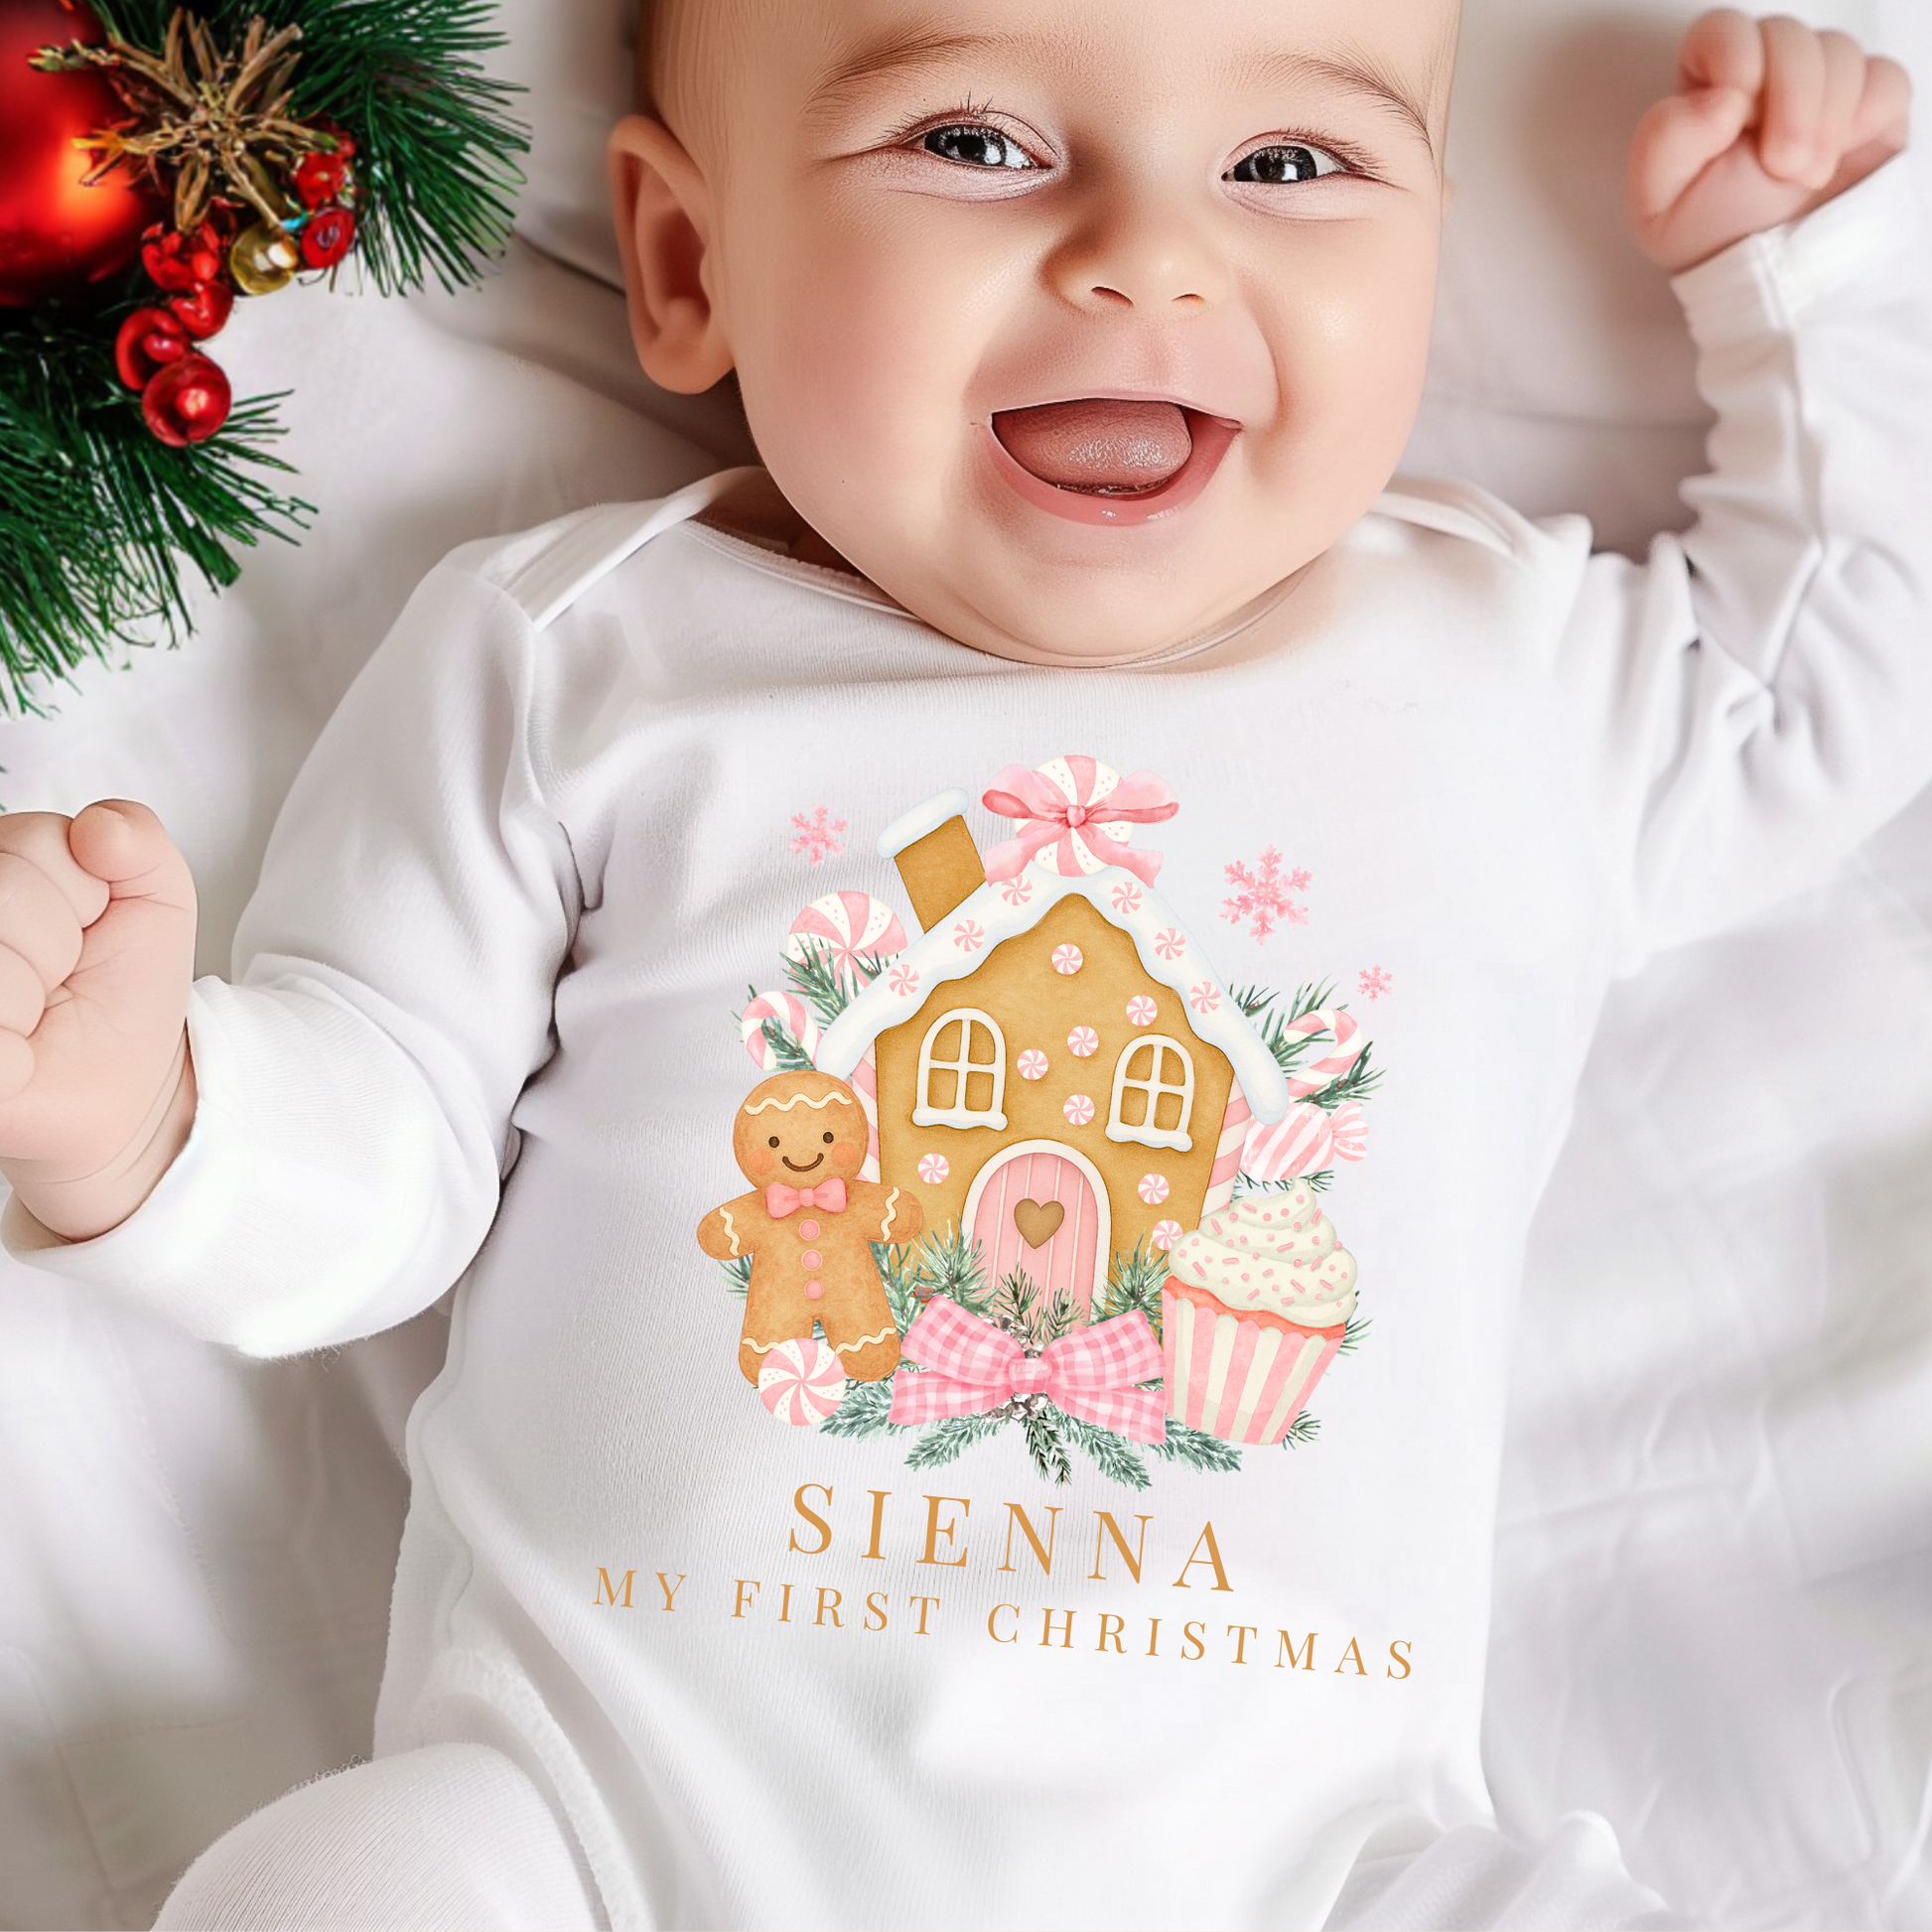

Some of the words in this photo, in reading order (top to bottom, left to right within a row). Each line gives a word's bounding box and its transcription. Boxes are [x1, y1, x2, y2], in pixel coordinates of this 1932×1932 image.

[788, 1483, 1234, 1592] SIENNA
[592, 1566, 687, 1612] MY
[730, 1579, 941, 1636] FIRST
[987, 1603, 1413, 1680] CHRISTMAS
